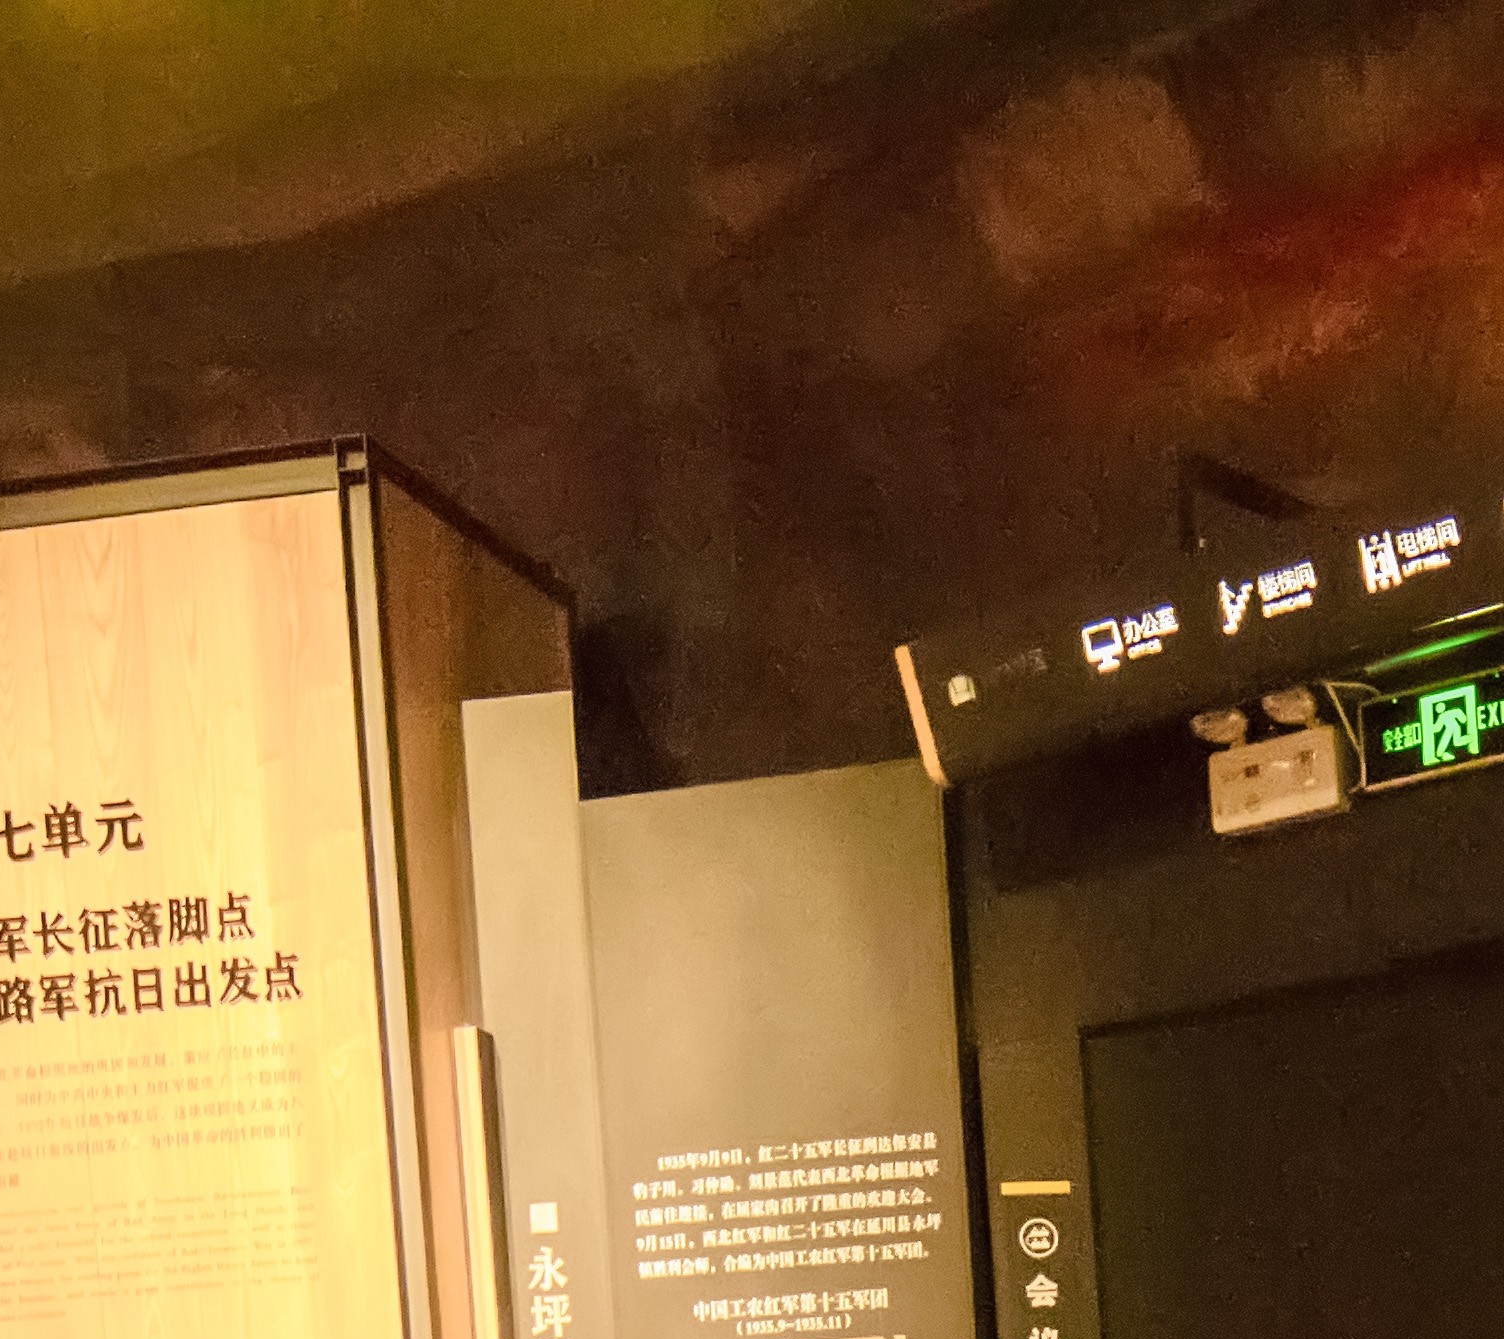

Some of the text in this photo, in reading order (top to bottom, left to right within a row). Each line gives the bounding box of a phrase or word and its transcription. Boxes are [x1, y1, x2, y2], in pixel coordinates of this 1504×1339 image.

[1396, 514, 1461, 558] 电梯间
[1257, 559, 1318, 602] 楼梯间
[1123, 603, 1179, 645] 办公室
[693, 1288, 889, 1322] 中国工农红军第十五军团
